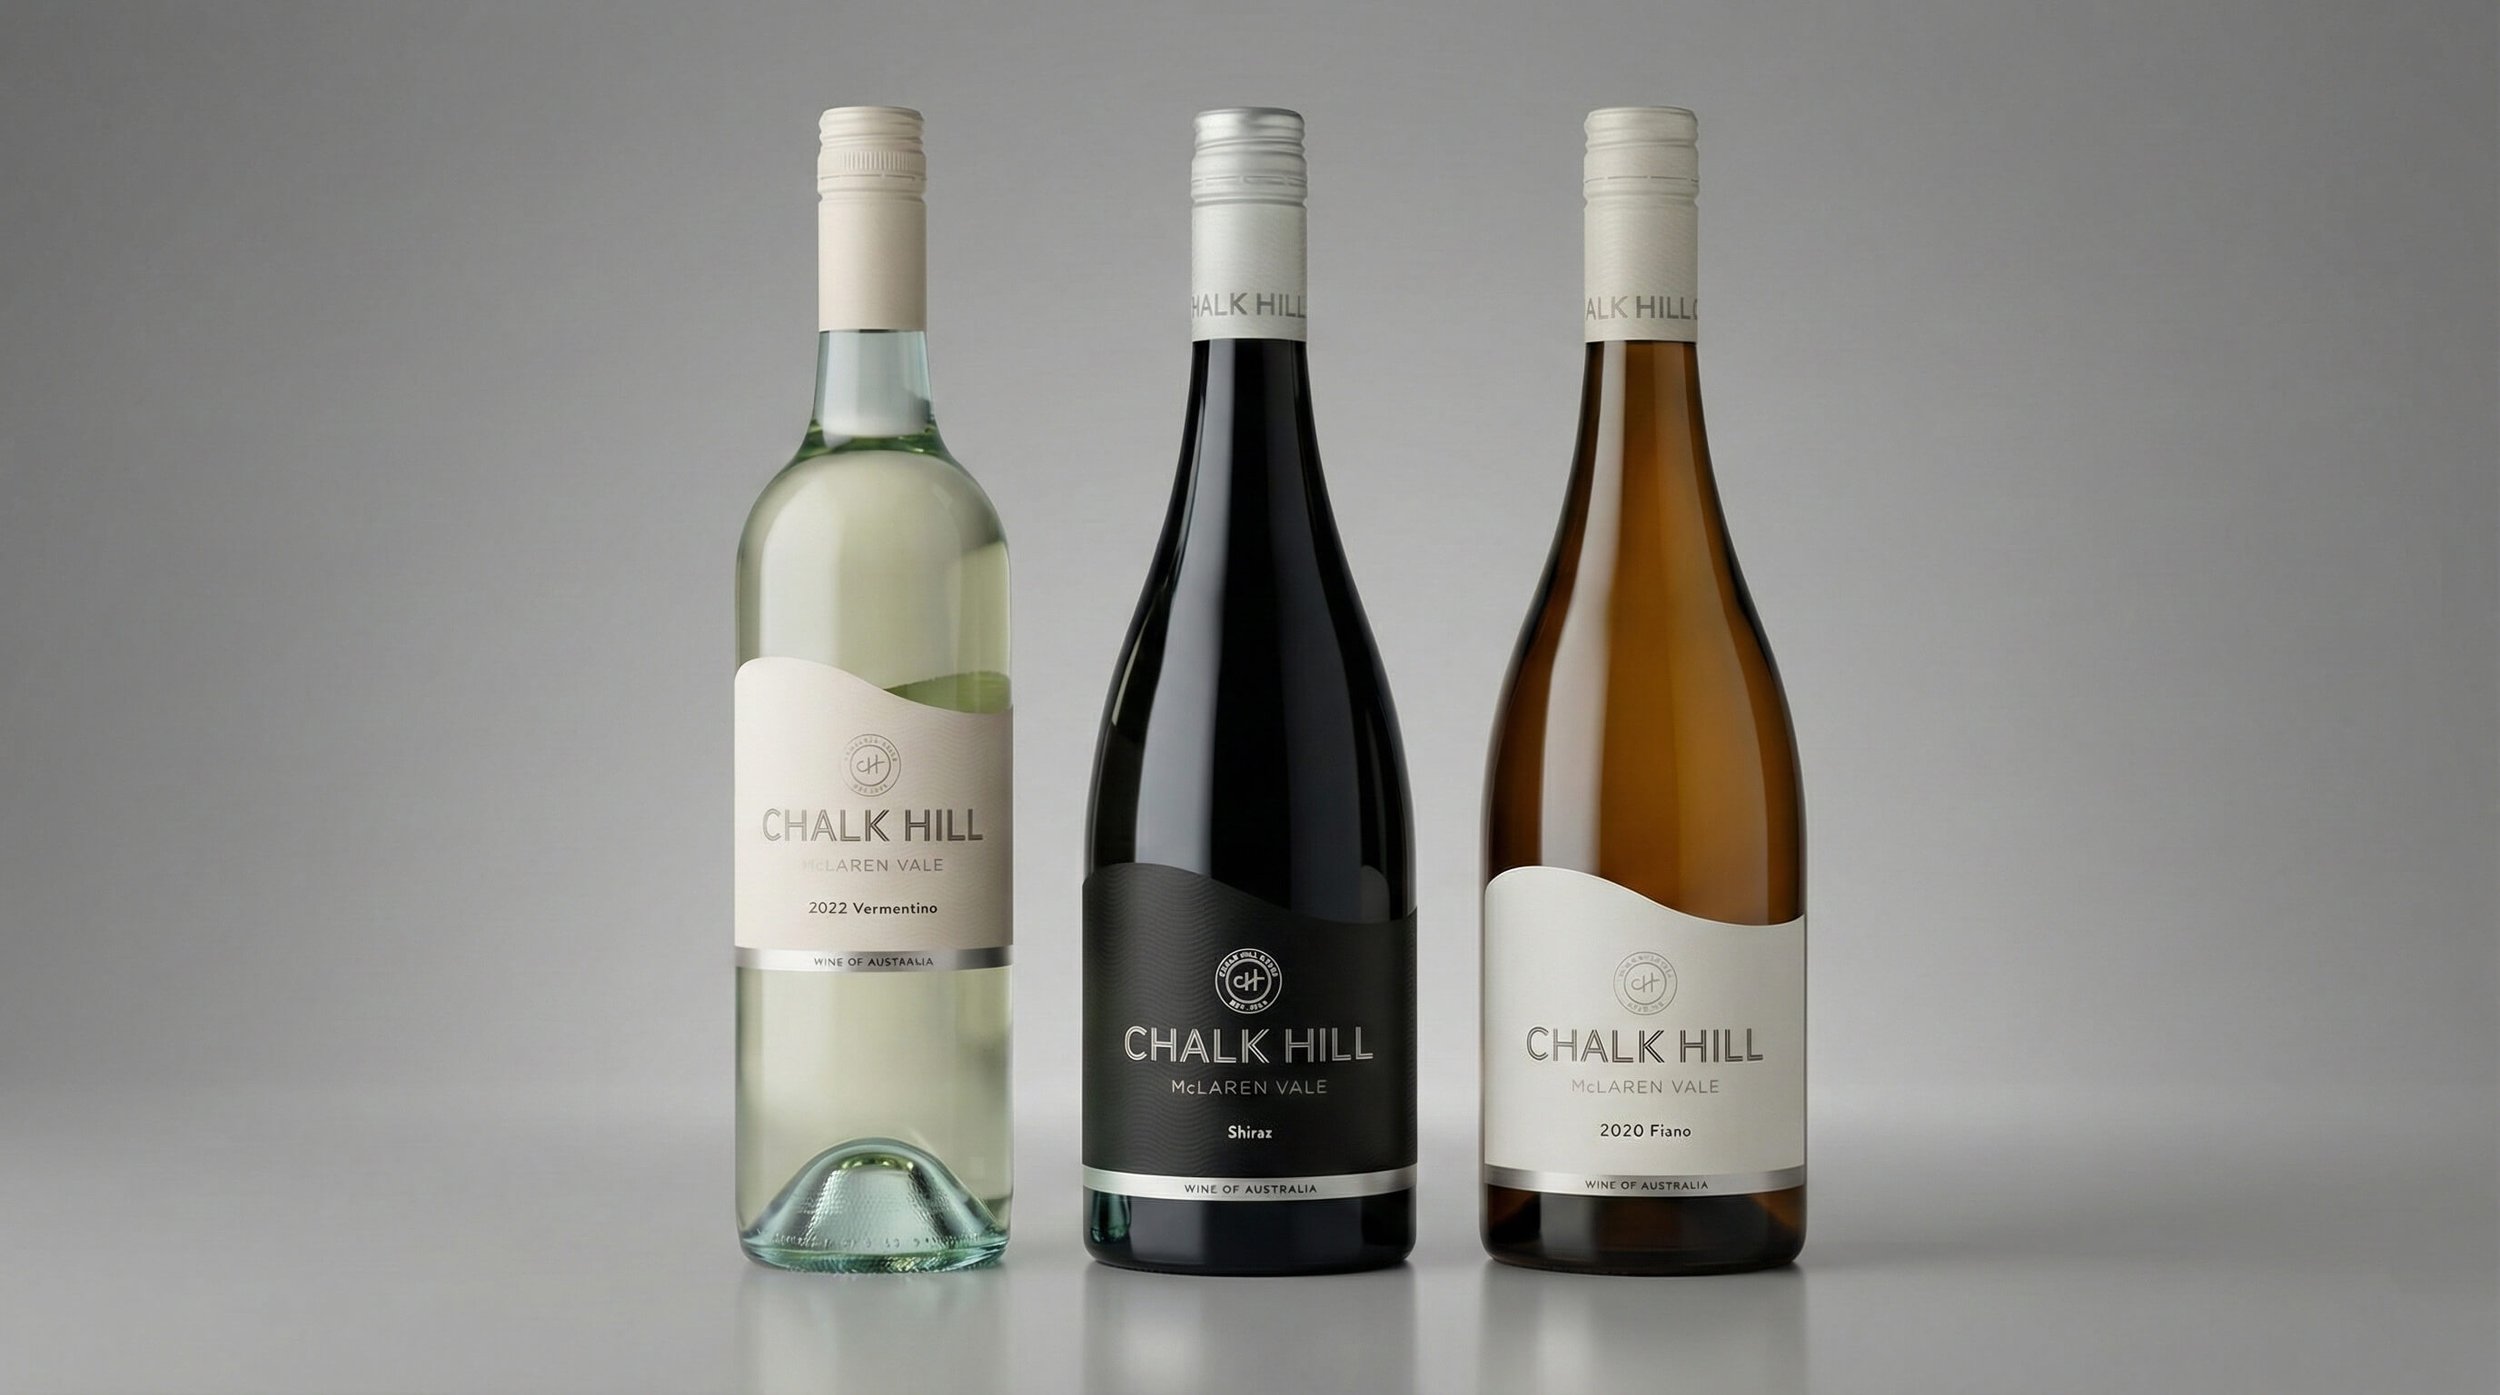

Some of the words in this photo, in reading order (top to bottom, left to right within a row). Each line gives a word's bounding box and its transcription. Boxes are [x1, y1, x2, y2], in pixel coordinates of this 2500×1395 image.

[1256, 293, 1306, 319] HILL
[762, 808, 890, 842] CHALK
[905, 808, 984, 842] HILL
[897, 858, 944, 872] VALE
[808, 901, 848, 914] 2022
[853, 902, 938, 915] Vermentino
[814, 957, 843, 967] WINE
[848, 957, 863, 967] OF
[1124, 1025, 1270, 1065] CHALK
[1284, 1026, 1374, 1064] HILL
[1525, 1026, 1665, 1064] CHALK
[1679, 1027, 1764, 1063] HILL
[1171, 1079, 1268, 1095] McLAREN
[1277, 1079, 1328, 1095] VALE
[1571, 1079, 1663, 1094] McLAREN
[1671, 1079, 1720, 1094] VALE
[1227, 1125, 1273, 1139] Shiraz
[1599, 1123, 1644, 1138] 2020
[1650, 1123, 1692, 1138] Fiano
[1184, 1184, 1217, 1194] WINE
[1222, 1184, 1241, 1194] OF
[1245, 1184, 1317, 1194] AUSTRALIA
[1585, 1180, 1617, 1190] WINE
[1621, 1180, 1638, 1190] OF
[1641, 1180, 1709, 1190] AUSTRALIA
